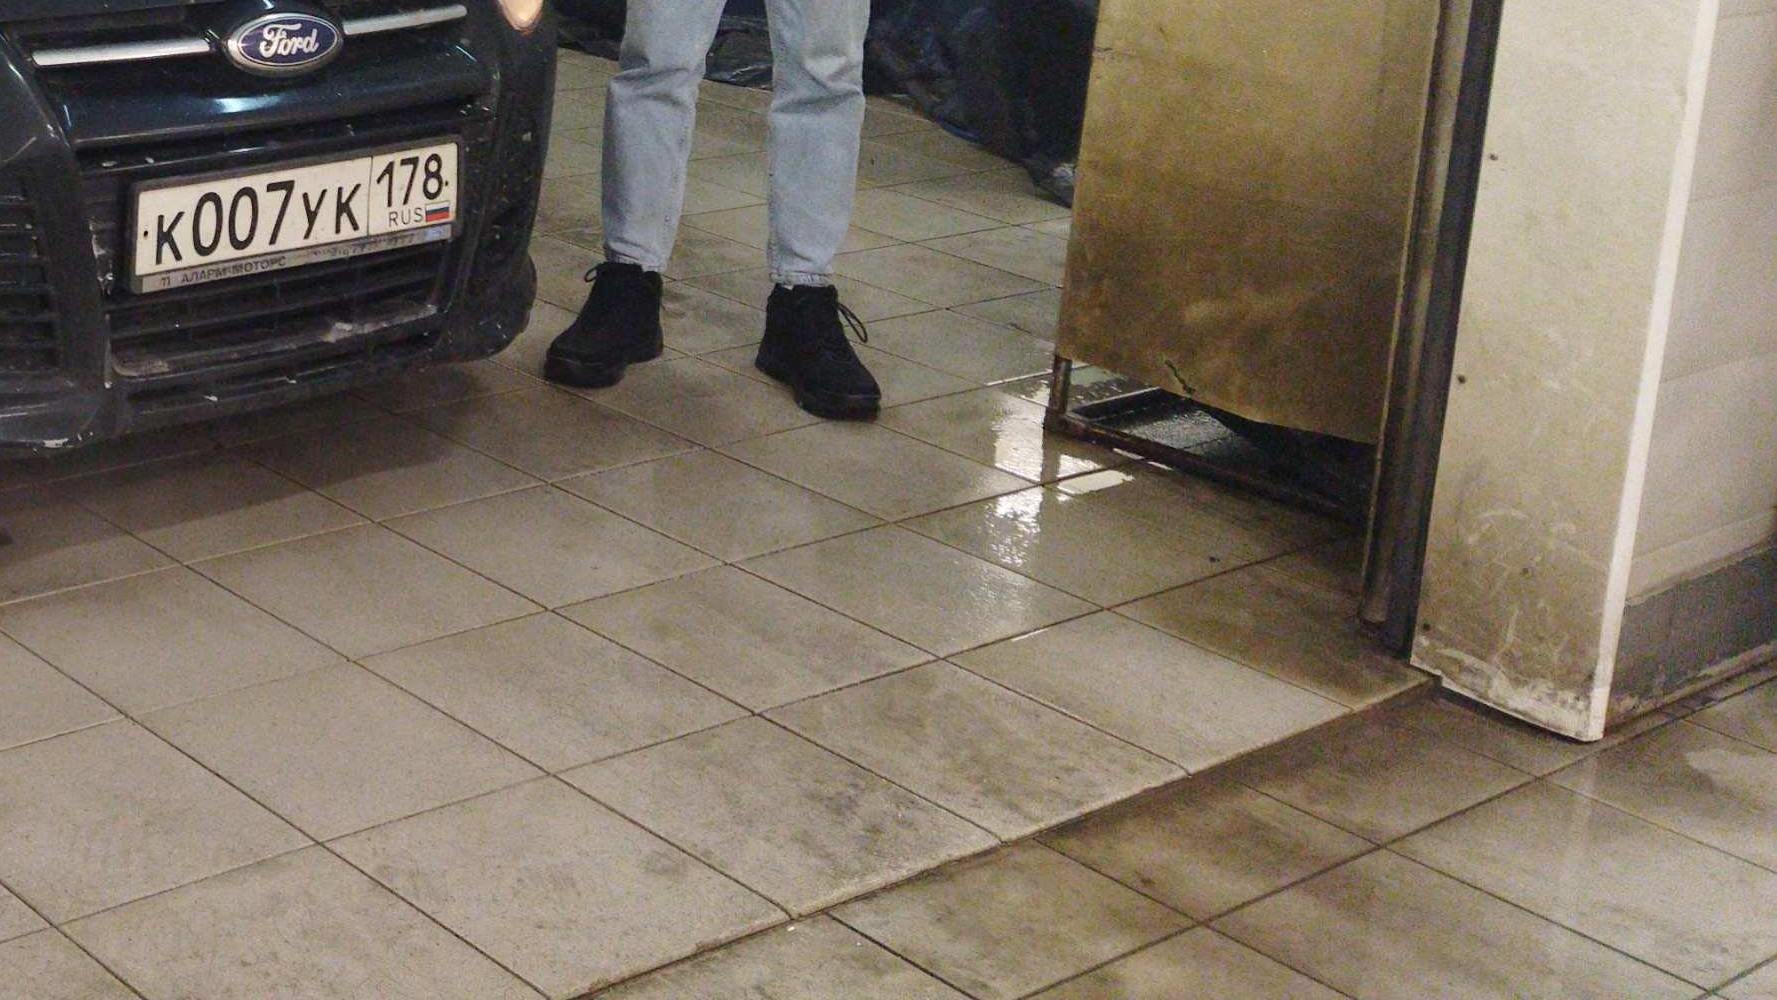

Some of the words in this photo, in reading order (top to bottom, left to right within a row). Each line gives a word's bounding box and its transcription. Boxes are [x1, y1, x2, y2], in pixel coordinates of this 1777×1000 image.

[259, 23, 320, 58] Ford
[376, 153, 443, 206] 178
[388, 207, 424, 228] RUS
